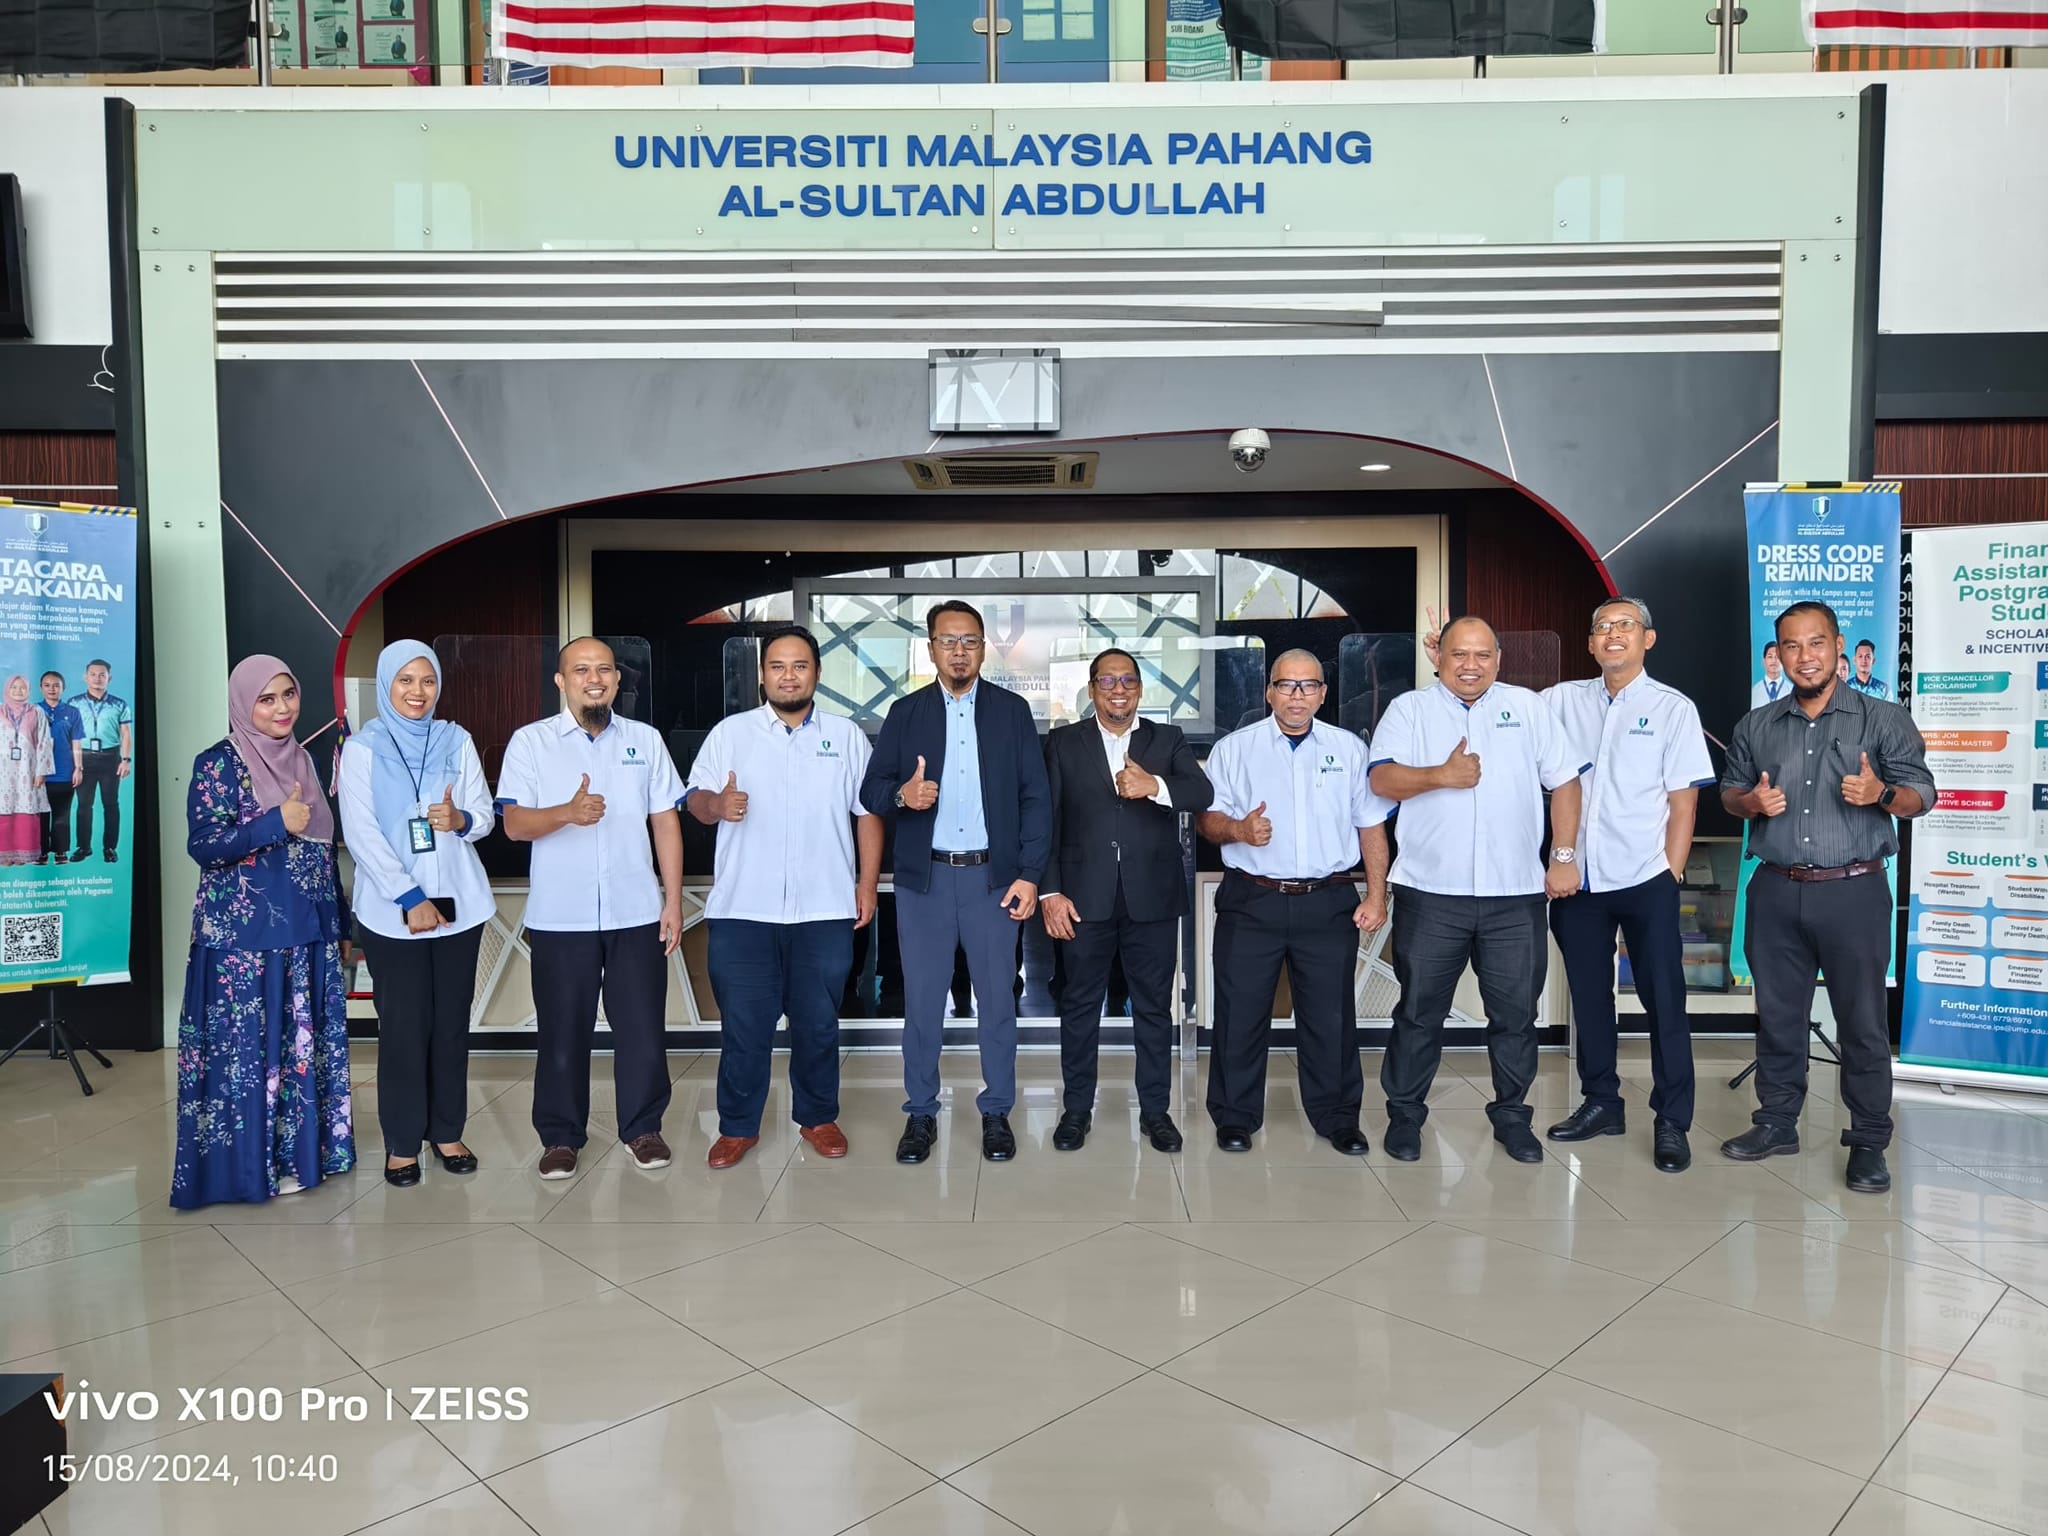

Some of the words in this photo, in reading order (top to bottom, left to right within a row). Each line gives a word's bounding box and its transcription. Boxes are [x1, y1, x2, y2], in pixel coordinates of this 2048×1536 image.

[615, 135, 887, 168] UNIVERSITI
[907, 133, 1152, 167] MALAYSIA
[1168, 131, 1372, 165] PAHANG
[718, 185, 984, 217] AL-SULTAN
[1001, 182, 1265, 215] ABDULLAH
[1757, 544, 1821, 563] DRESS
[1826, 544, 1884, 563] CODE
[0, 558, 108, 582] TACARA
[1765, 563, 1874, 582] REMINDER
[0, 577, 123, 602] PAKAIAN
[1812, 587, 1820, 596] the
[1822, 588, 1842, 598] Campus
[1959, 584, 2048, 604] Postgra
[1844, 597, 1856, 606] and
[20, 602, 43, 612] dalam
[46, 604, 76, 614] Kawasan
[1864, 607, 1872, 616] the
[1992, 603, 2048, 622] Stud
[7, 612, 36, 621] sentiasa
[38, 612, 78, 623] berpakaian
[10, 623, 28, 631] yang
[30, 624, 82, 633] mencerminkan
[19, 630, 44, 641] pelajar
[1965, 644, 1975, 654] &
[1942, 674, 1994, 682] CHANCELLOR
[1923, 682, 1978, 690] SCHOLARSHIP
[1926, 740, 1960, 748] AMBUNG
[1961, 800, 1994, 808] SCHEME
[1924, 882, 1948, 890] Hospital
[1950, 882, 1980, 890] Treatment
[2010, 892, 2046, 900] Disabilities
[1932, 920, 1952, 928] Family
[2008, 964, 2043, 974] Emergency
[1933, 972, 1966, 980] Assistance
[2008, 978, 2042, 986] Assistance
[1940, 1000, 1981, 1012] Further
[1984, 1003, 2048, 1017] Information
